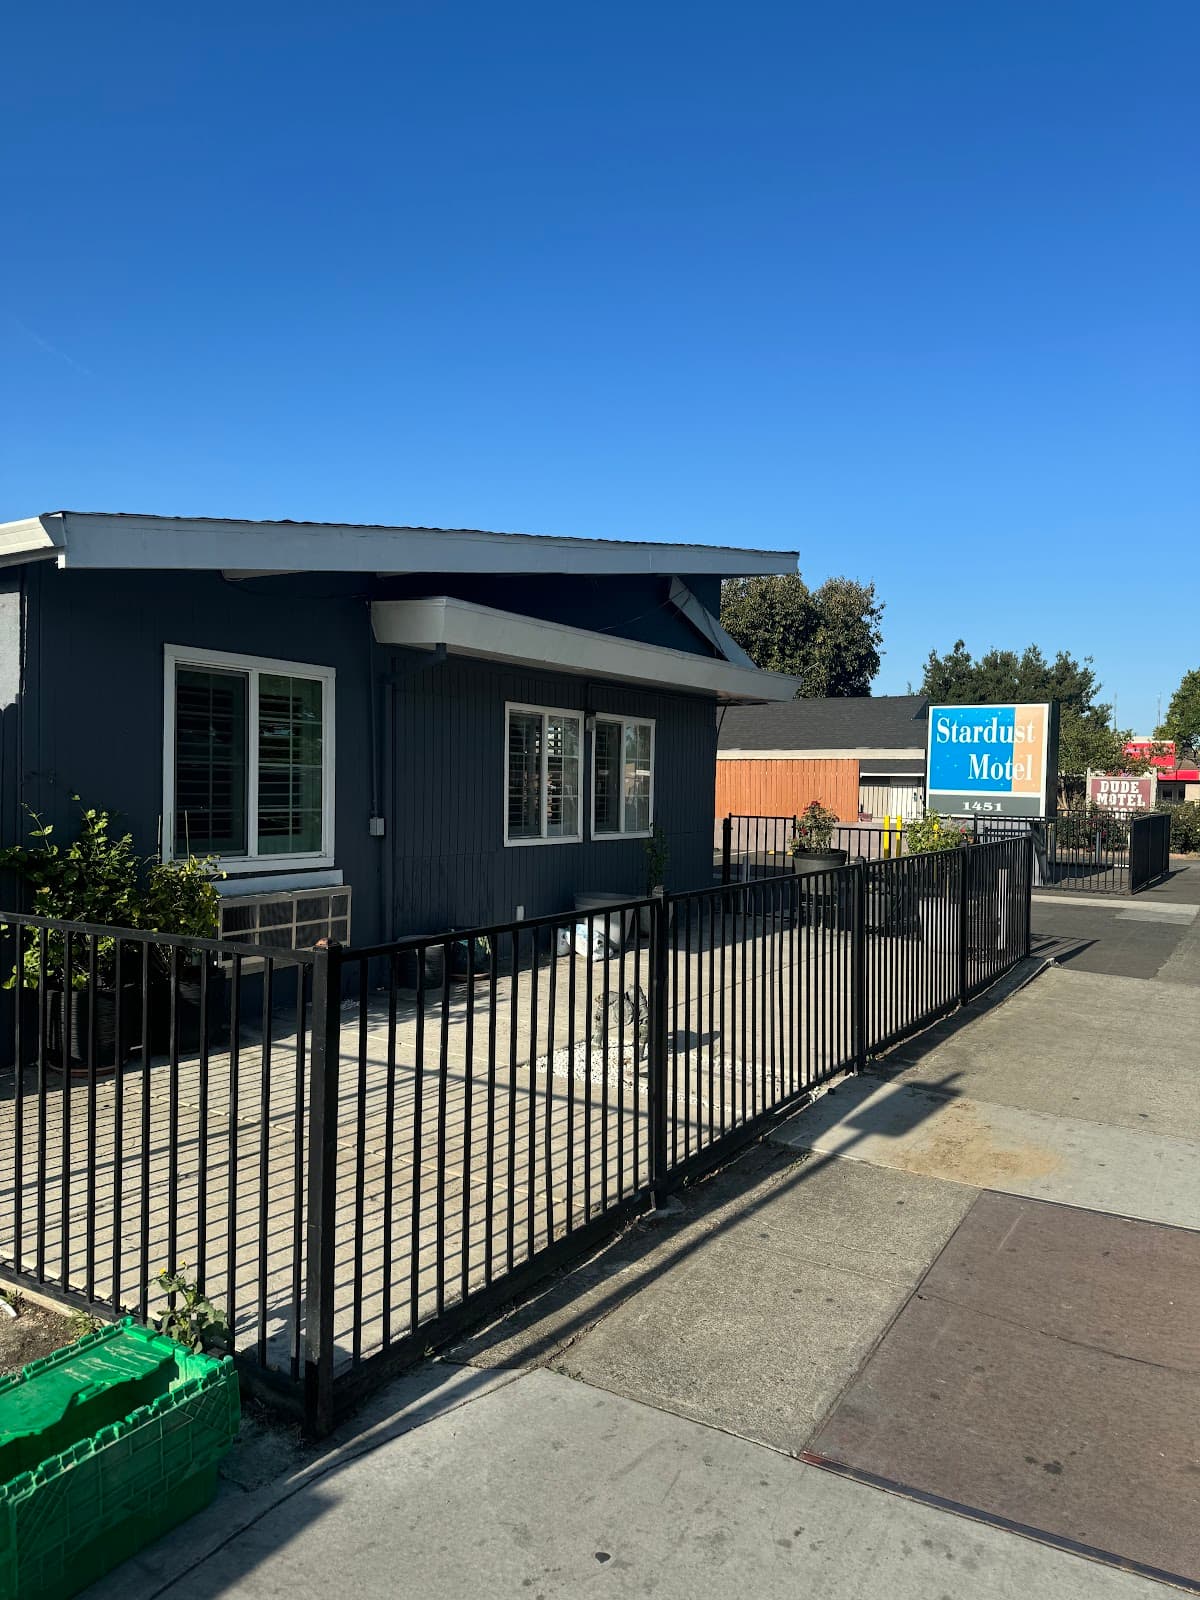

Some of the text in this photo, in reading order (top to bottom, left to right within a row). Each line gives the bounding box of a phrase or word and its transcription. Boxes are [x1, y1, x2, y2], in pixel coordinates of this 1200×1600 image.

[936, 717, 1036, 743] Stardust
[967, 753, 1033, 781] Motel
[1100, 780, 1139, 793] DUDE
[962, 801, 1003, 812] 1451
[1096, 793, 1146, 807] MOTEL
